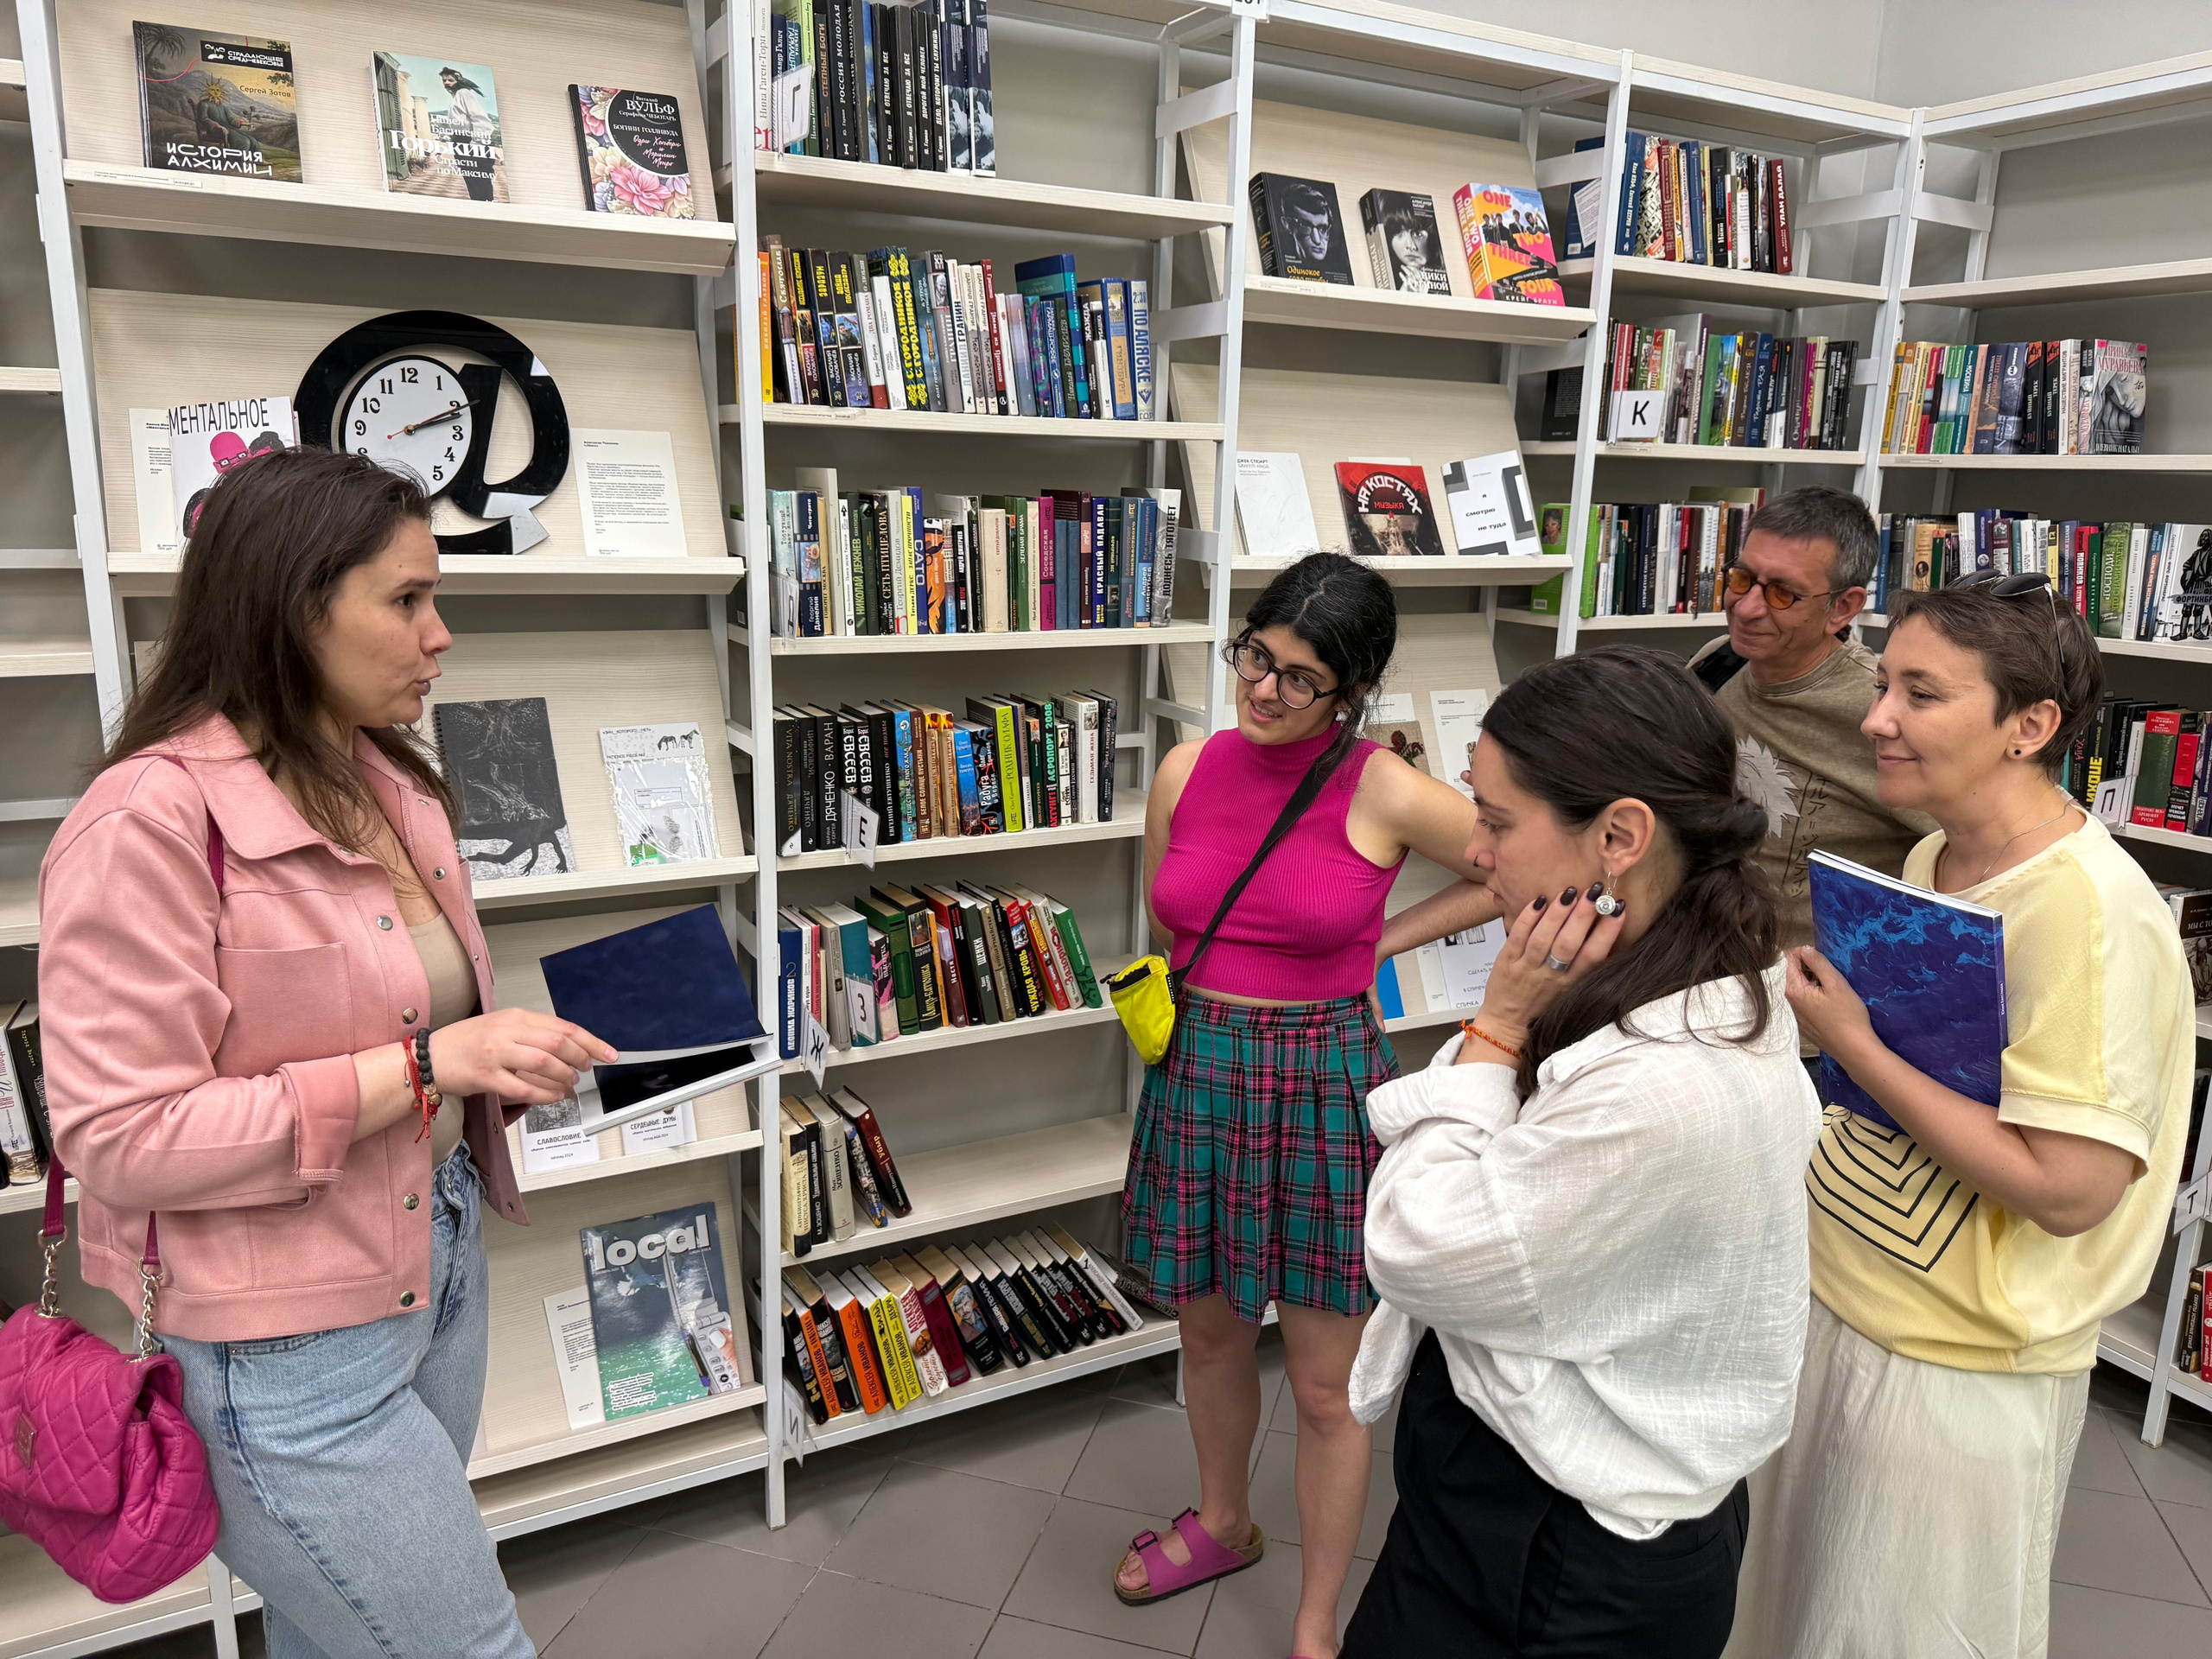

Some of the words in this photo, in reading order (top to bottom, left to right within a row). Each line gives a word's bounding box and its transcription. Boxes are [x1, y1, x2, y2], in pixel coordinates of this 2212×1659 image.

[834, 4, 844, 58] МОЛОДАЯ
[837, 60, 846, 104] РОССИЯ
[884, 66, 890, 76] ЗА
[905, 67, 912, 77] ЗА
[239, 85, 267, 96] Сергей
[269, 88, 291, 98] Зотов
[933, 73, 942, 106] КОТОРОМУ
[626, 99, 675, 115] ВУЛЬФ
[920, 91, 929, 120] ДОРОГОЙ
[431, 124, 492, 140] Басинский
[613, 124, 640, 132] БОГИНИ
[166, 142, 263, 162] ИСТОРИЯ
[389, 130, 498, 160] Горький
[435, 155, 478, 168] Страсти
[436, 167, 450, 175] по
[450, 167, 498, 182] Максиму
[1777, 165, 1786, 200] ДАЛАЙ
[1483, 189, 1511, 208] ONE
[1456, 194, 1466, 226] THREE
[1463, 228, 1473, 257] FOUR
[1469, 217, 1479, 244] TWO
[1513, 231, 1545, 246] TWO
[1491, 244, 1534, 267] THREE
[1287, 265, 1320, 276] Одинокое
[1505, 295, 1529, 303] КРЕЙГ
[1533, 296, 1558, 305] БРАУН
[1518, 278, 1556, 295] FOUR
[954, 302, 965, 344] ГРАНИН
[1133, 308, 1147, 325] ПО
[1135, 328, 1152, 384] АЛЯСКЕ
[2098, 356, 2143, 374] МУРАВЬЁВА
[2104, 346, 2127, 358] ИРИНА
[379, 378, 394, 395] 11
[400, 367, 419, 384] 12
[435, 375, 443, 391] 1
[168, 397, 270, 436] МЕНТАЛЬНОЕ
[362, 397, 380, 414] 10
[1632, 400, 1649, 425] К
[354, 420, 366, 435] 9
[452, 425, 464, 441] 3
[444, 447, 455, 462] 4
[433, 465, 444, 480] 5
[1357, 488, 1370, 513] НА
[1366, 474, 1423, 516] КОСТЯХ
[1374, 501, 1404, 510] МУЗЫКА
[1465, 507, 1496, 518] смотрю
[1488, 521, 1507, 531] туда
[878, 510, 890, 571] ПТИЦЕЛОВА
[1166, 505, 1176, 551] ТЯГОТЕЕТ
[852, 537, 862, 575] ДЕЖНЕВ
[914, 539, 925, 586] САТО
[2076, 552, 2085, 585] НОВИКОВ
[880, 571, 892, 600] СЕТЬ
[1096, 550, 1104, 594] КРАСНЫЙ
[1162, 552, 1173, 597] ДОДНЕСЬ
[855, 578, 866, 615] НИКОЛАЙ
[813, 596, 822, 631] Данелия
[1044, 703, 1053, 729] 2008
[824, 721, 834, 762] ВАРАН
[842, 734, 857, 784] ЕВСЕЕВ
[857, 734, 872, 784] ЕВСЕЕВ
[1003, 744, 1014, 780] РОДНИК
[824, 771, 836, 822] ДЯЧЕНКО
[884, 762, 893, 805] ЕВТУШЕНКО
[980, 775, 991, 806] Радуга
[786, 793, 795, 832] ДЯЧЕНКО
[803, 791, 811, 828] ДЯЧЕНКО
[1049, 791, 1058, 827] АХТУНГ!
[2101, 788, 2116, 814] П
[858, 816, 868, 849] Е
[2187, 921, 2198, 931] МЫ
[973, 937, 987, 966] ЩЕНКИ
[1020, 949, 1032, 977] КРОВЬ
[785, 962, 797, 978] 2
[950, 960, 958, 984] Настя
[537, 1132, 582, 1146] СЛАВОСЛОВИЕ
[834, 1150, 843, 1190] ЗОЩЕНКО
[2187, 1189, 2198, 1214] Т
[592, 1214, 710, 1271] local
[887, 1297, 898, 1320] ДЕБРИ
[900, 1293, 918, 1334] АЛЕКСЕЙ
[857, 1340, 871, 1374] ИВАНОВ
[882, 1338, 896, 1368] ИВАНОВ
[896, 1331, 911, 1361] ИВАНОВ
[813, 1348, 827, 1378] ИВАНОВ
[905, 1357, 918, 1388] АЛЕКСЕЙ
[823, 1377, 836, 1408] АЛЕКСЕЙ
[866, 1370, 880, 1403] АЛЕКСЕЙ
[891, 1364, 904, 1397] АЛЕКСЕЙ
